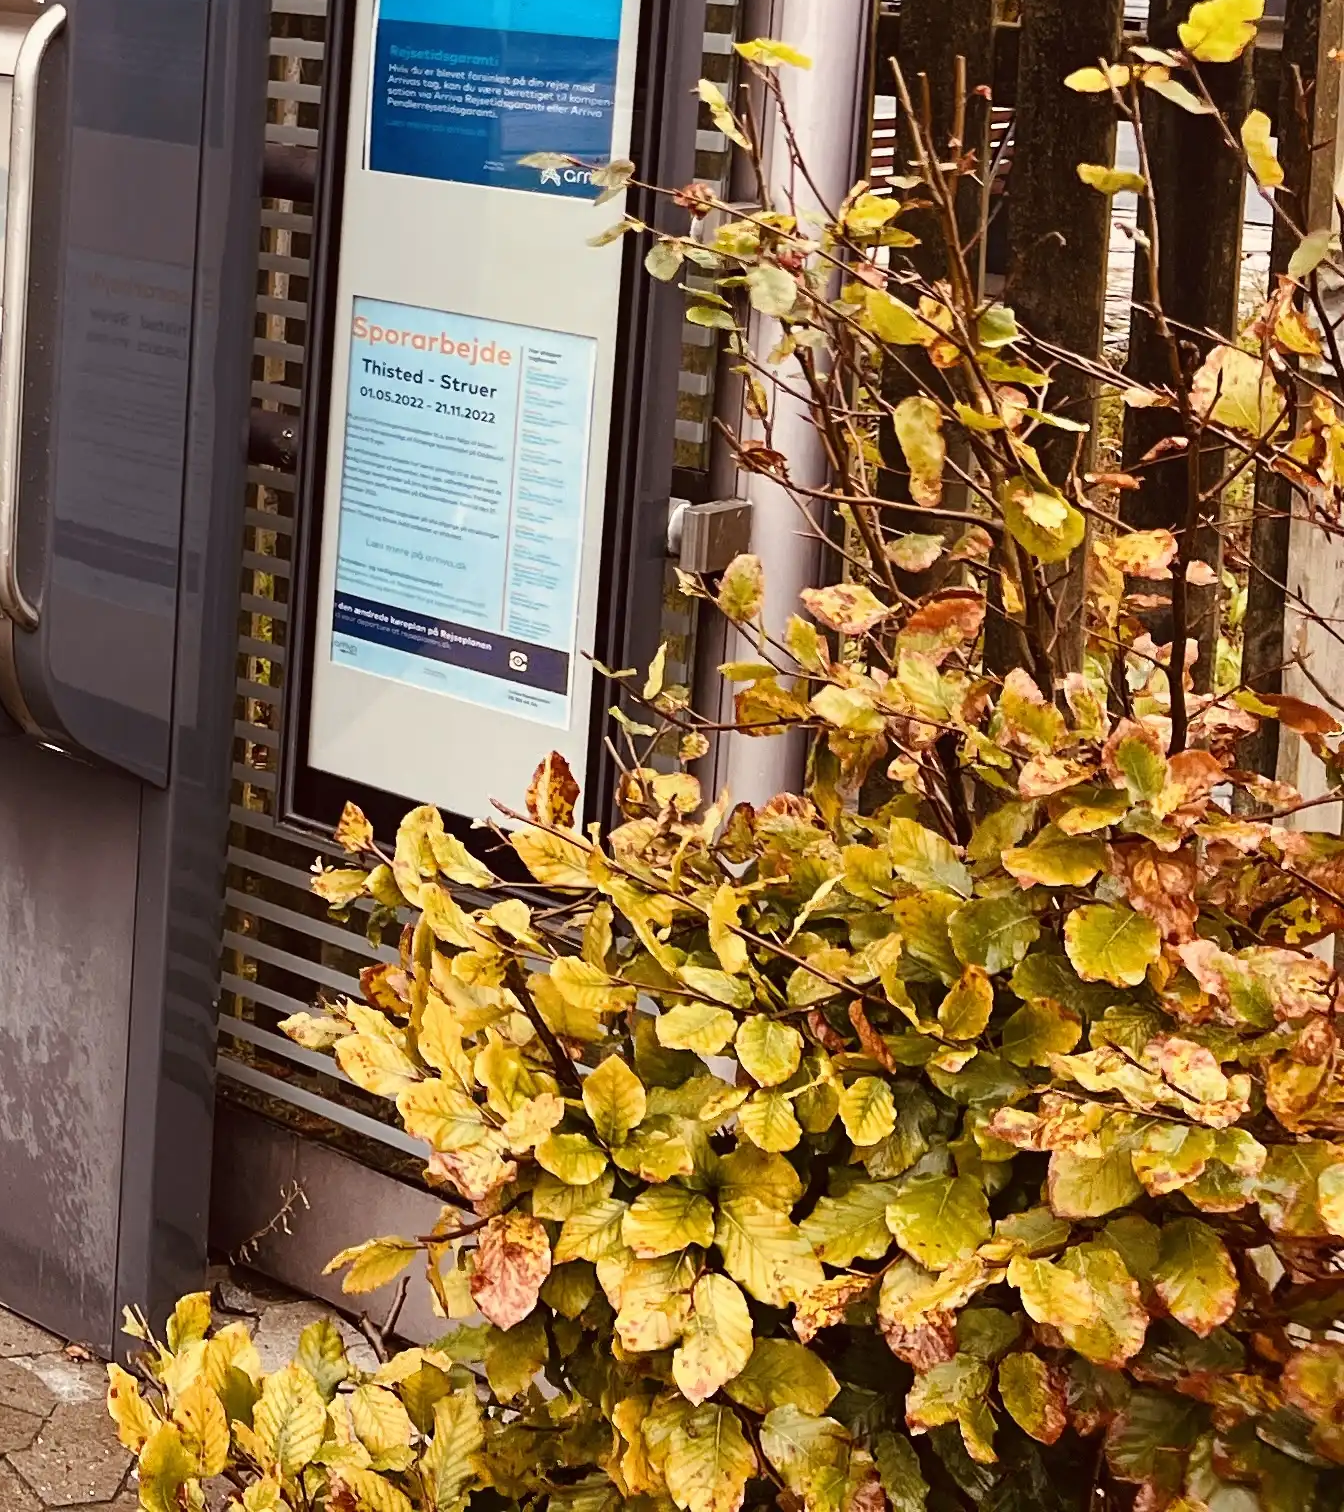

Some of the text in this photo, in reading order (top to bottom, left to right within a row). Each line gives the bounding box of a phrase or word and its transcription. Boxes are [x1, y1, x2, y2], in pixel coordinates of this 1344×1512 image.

[390, 44, 499, 67] Rejsetidsgaranti
[387, 75, 421, 87] Arrivas
[443, 81, 461, 90] kan
[463, 83, 475, 92] du
[478, 86, 502, 96] være
[503, 88, 554, 101] berettiget
[557, 93, 567, 101] til
[569, 93, 615, 107] kompen-
[411, 66, 423, 75] du
[512, 76, 525, 86] på
[527, 77, 544, 88] din
[546, 81, 569, 91] rejse
[387, 88, 416, 97] sation
[433, 92, 462, 103] Arriva
[465, 94, 544, 111] Rejsetidsgaranti
[547, 104, 568, 113] eller
[570, 106, 602, 118] Arriva
[352, 315, 512, 367] Sporarbejde
[362, 358, 423, 384] Thisted
[440, 375, 497, 399] Struer
[359, 386, 424, 409] 01.05.2022
[435, 402, 496, 424] 21.11.2022
[386, 544, 410, 557] mere
[411, 551, 424, 561] på
[338, 601, 352, 613] den
[354, 607, 389, 623] ændrede
[390, 615, 426, 633] køreplan
[428, 626, 439, 637] på
[440, 629, 493, 651] Rejseplanen
[357, 617, 391, 634] departure
[392, 627, 400, 636] at
